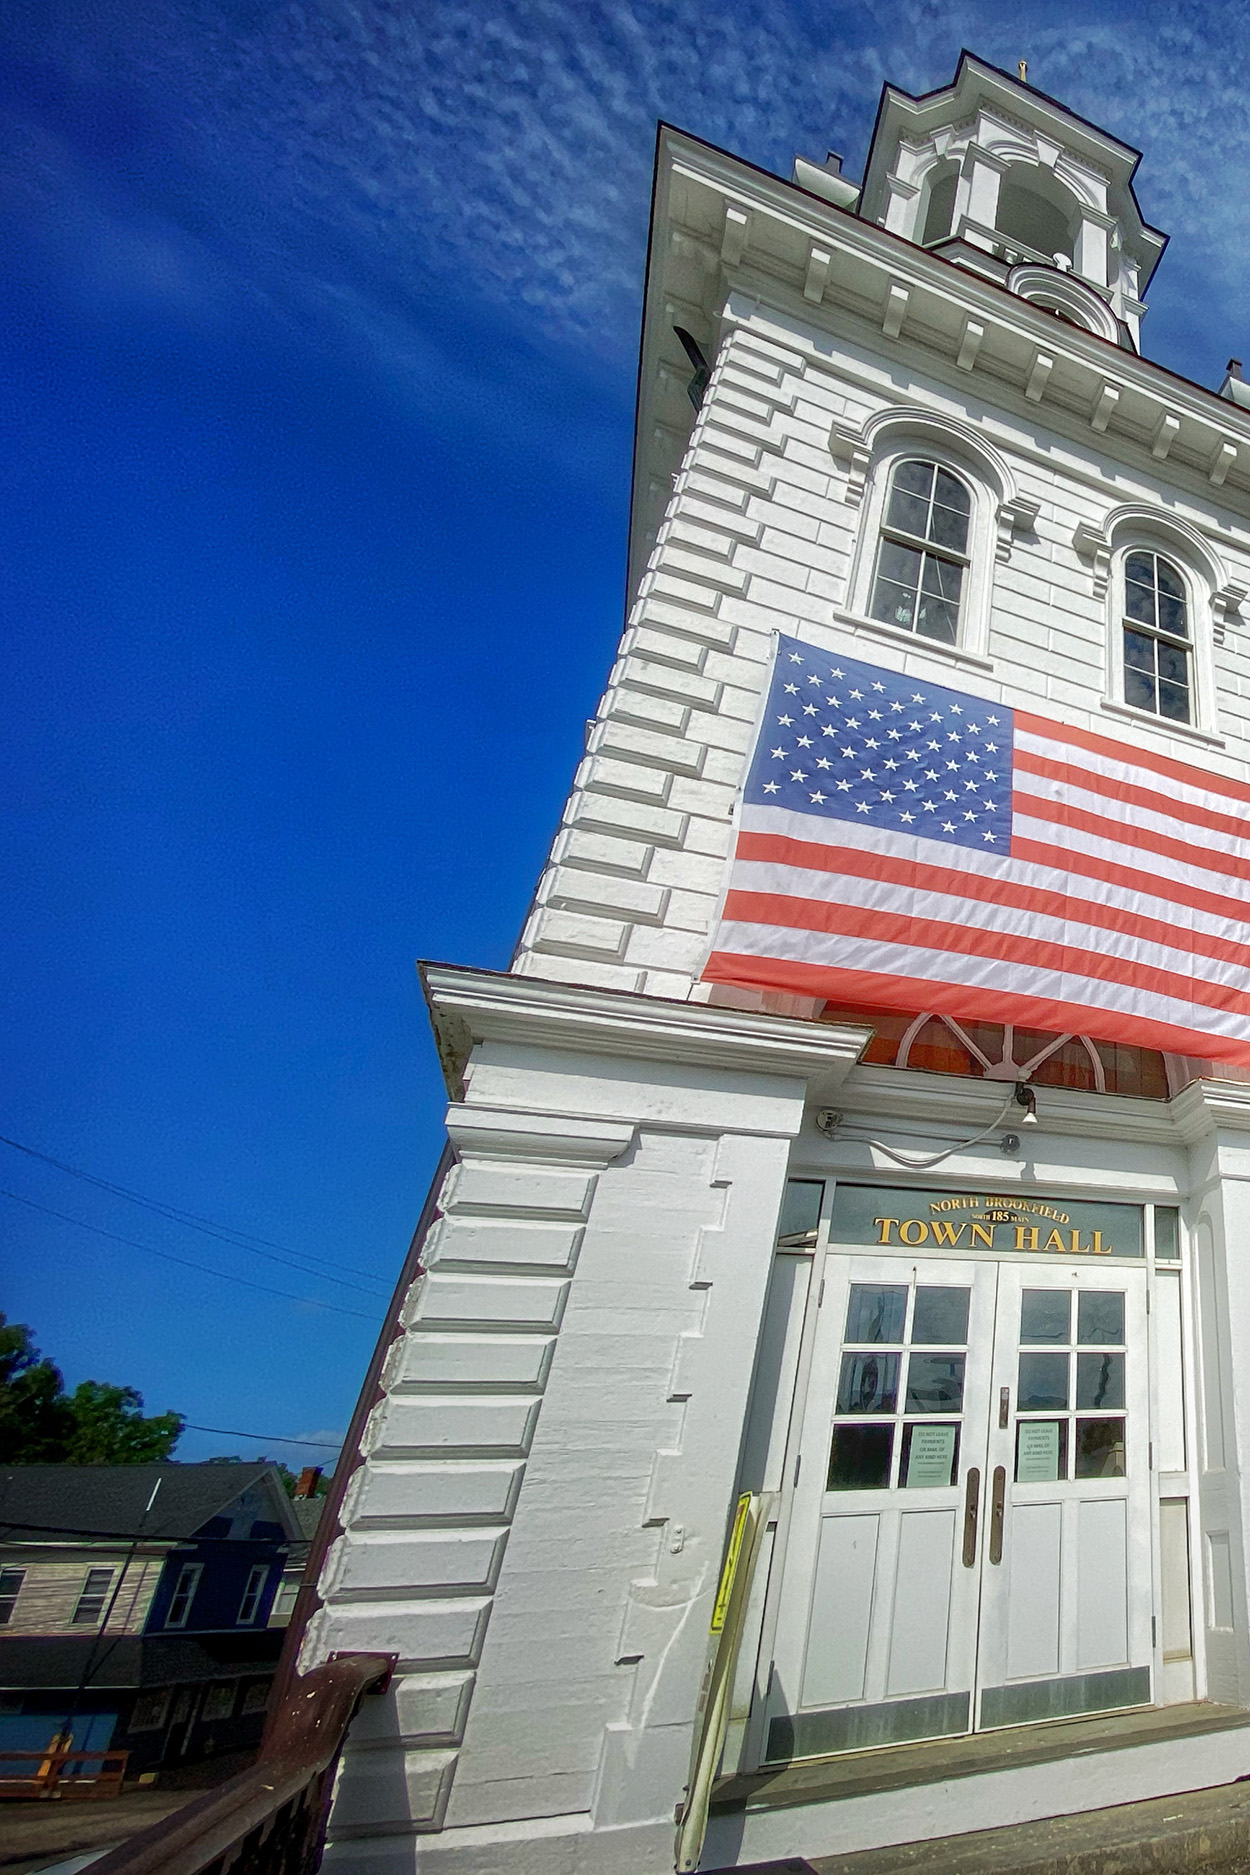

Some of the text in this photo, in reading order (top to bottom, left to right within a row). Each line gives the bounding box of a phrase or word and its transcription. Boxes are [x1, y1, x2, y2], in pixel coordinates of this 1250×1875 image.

[929, 1196, 1070, 1225] NORTH BROOKFIELD
[992, 1210, 1010, 1222] 185
[1010, 1215, 1030, 1223] MAIN
[874, 1217, 1113, 1255] TOWN HALL
